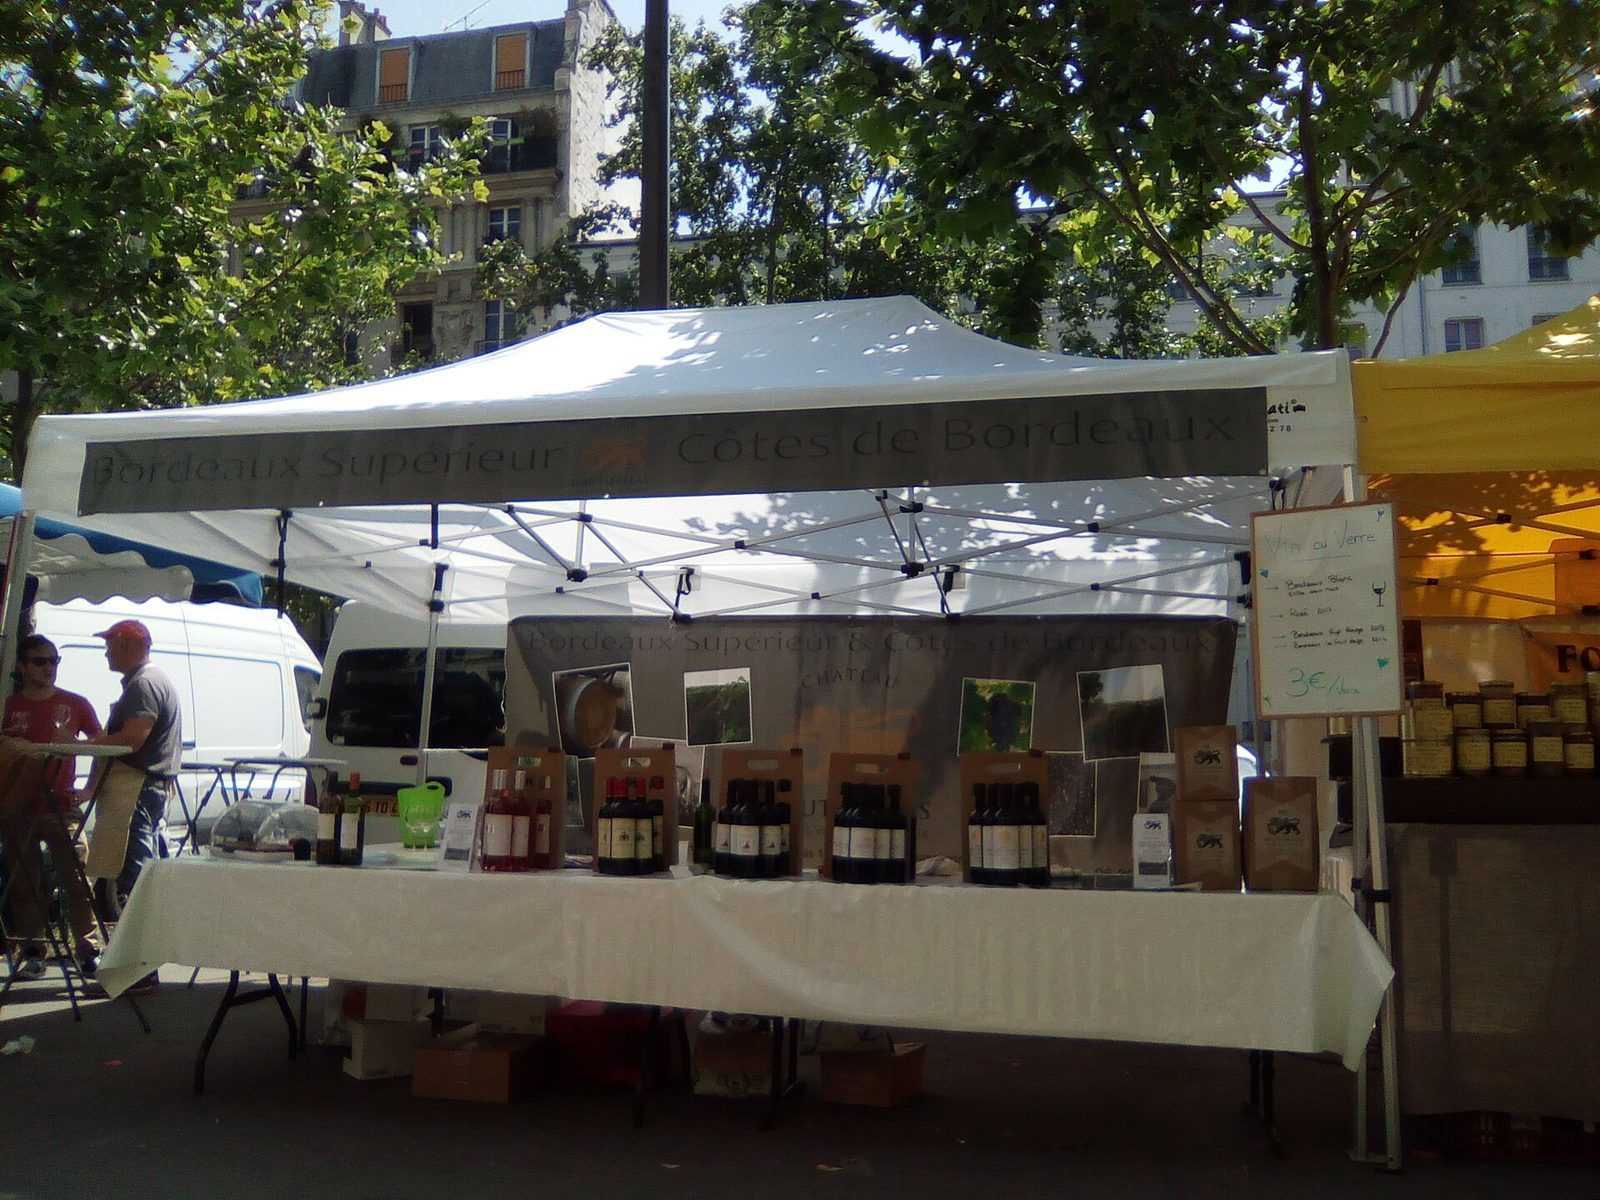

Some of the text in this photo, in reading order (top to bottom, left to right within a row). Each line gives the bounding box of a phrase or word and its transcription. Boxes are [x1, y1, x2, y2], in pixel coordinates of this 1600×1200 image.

[678, 411, 1234, 464] Côtes de Bordeaux
[95, 443, 562, 485] Bordeaux Supérieur
[1334, 519, 1376, 548] Verre
[528, 629, 1211, 656] Bordeaux Supérieur & Côtes de Bordeaux
